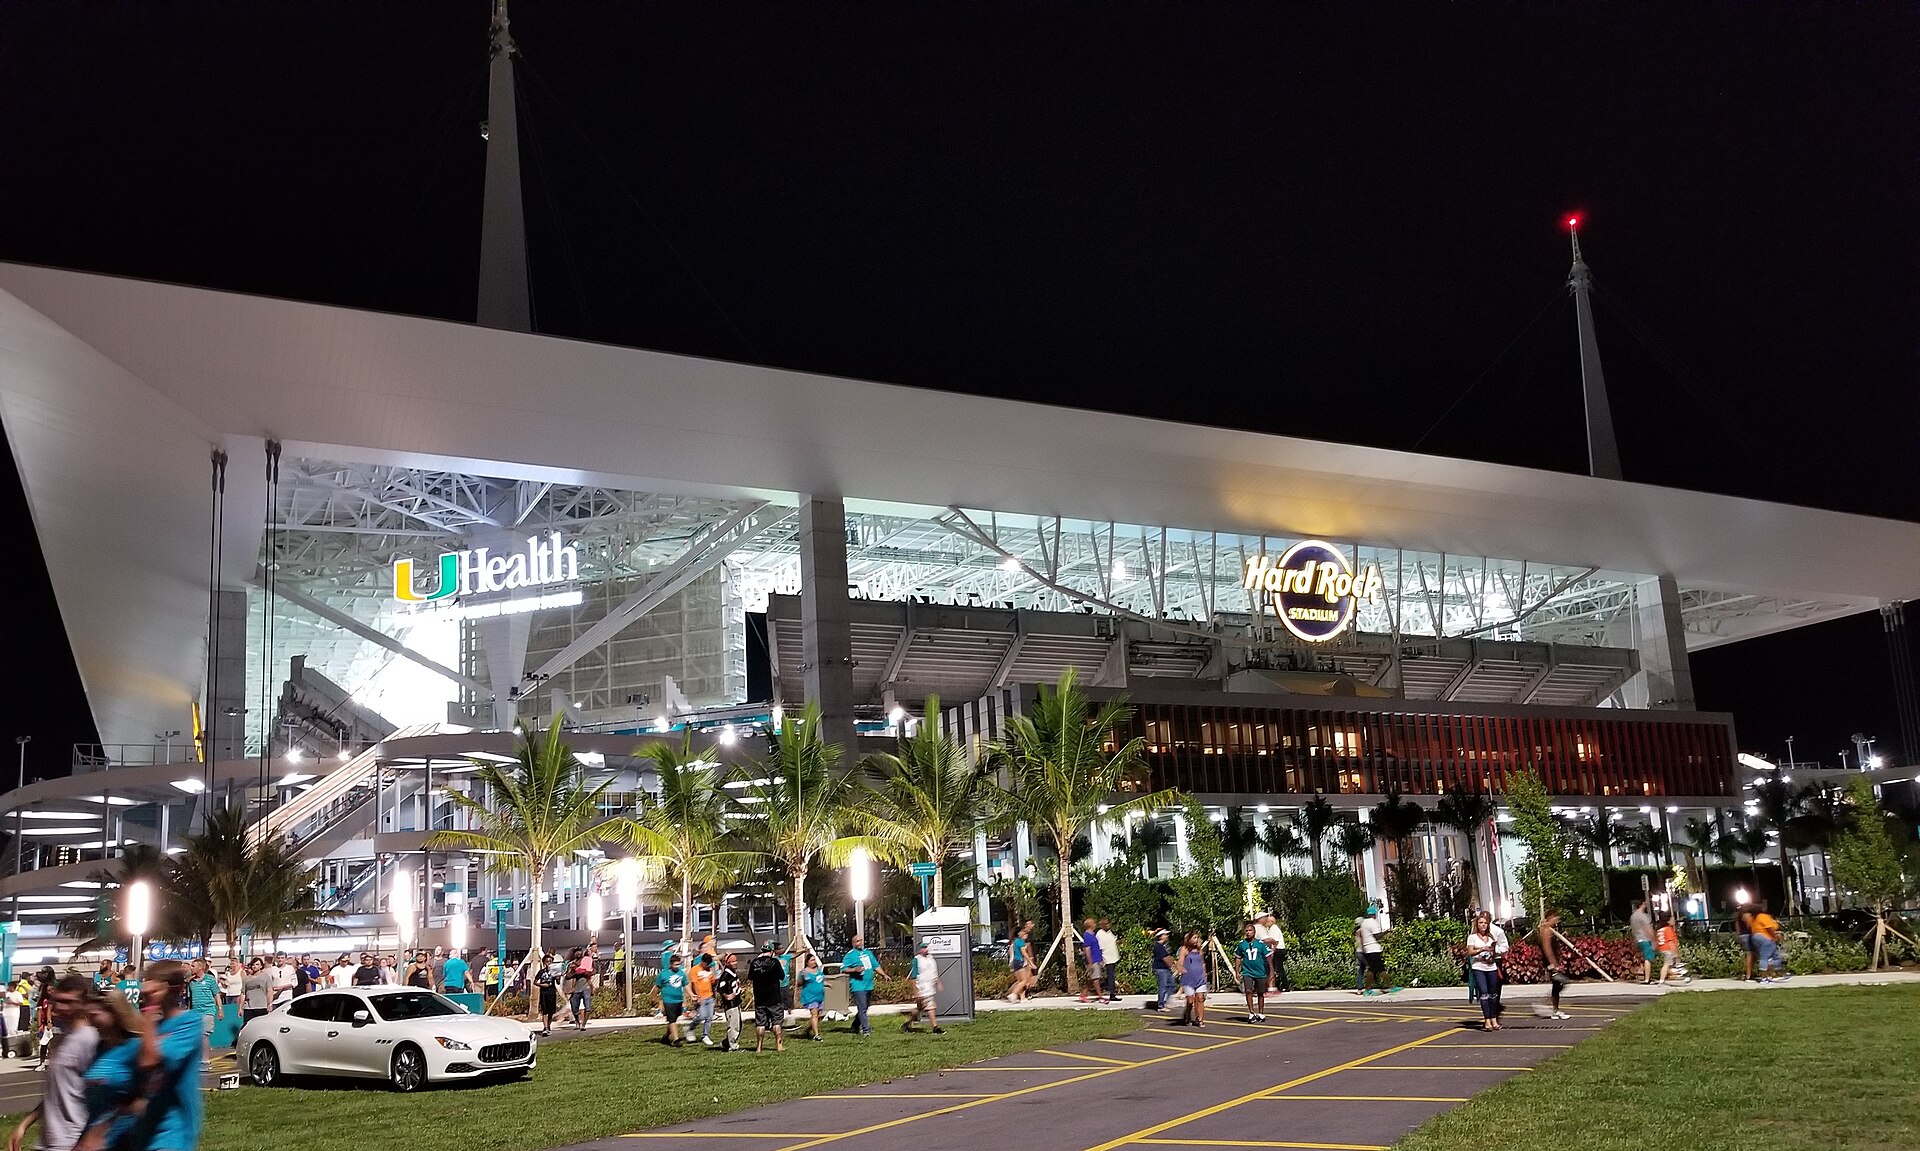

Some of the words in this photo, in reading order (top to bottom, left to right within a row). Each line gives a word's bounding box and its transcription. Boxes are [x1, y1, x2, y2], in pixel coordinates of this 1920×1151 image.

[1243, 555, 1316, 594] Hard
[1315, 561, 1382, 605] Rock
[1288, 607, 1339, 622] STADIUM
[1246, 947, 1258, 961] 17
[125, 988, 140, 1003] 23
